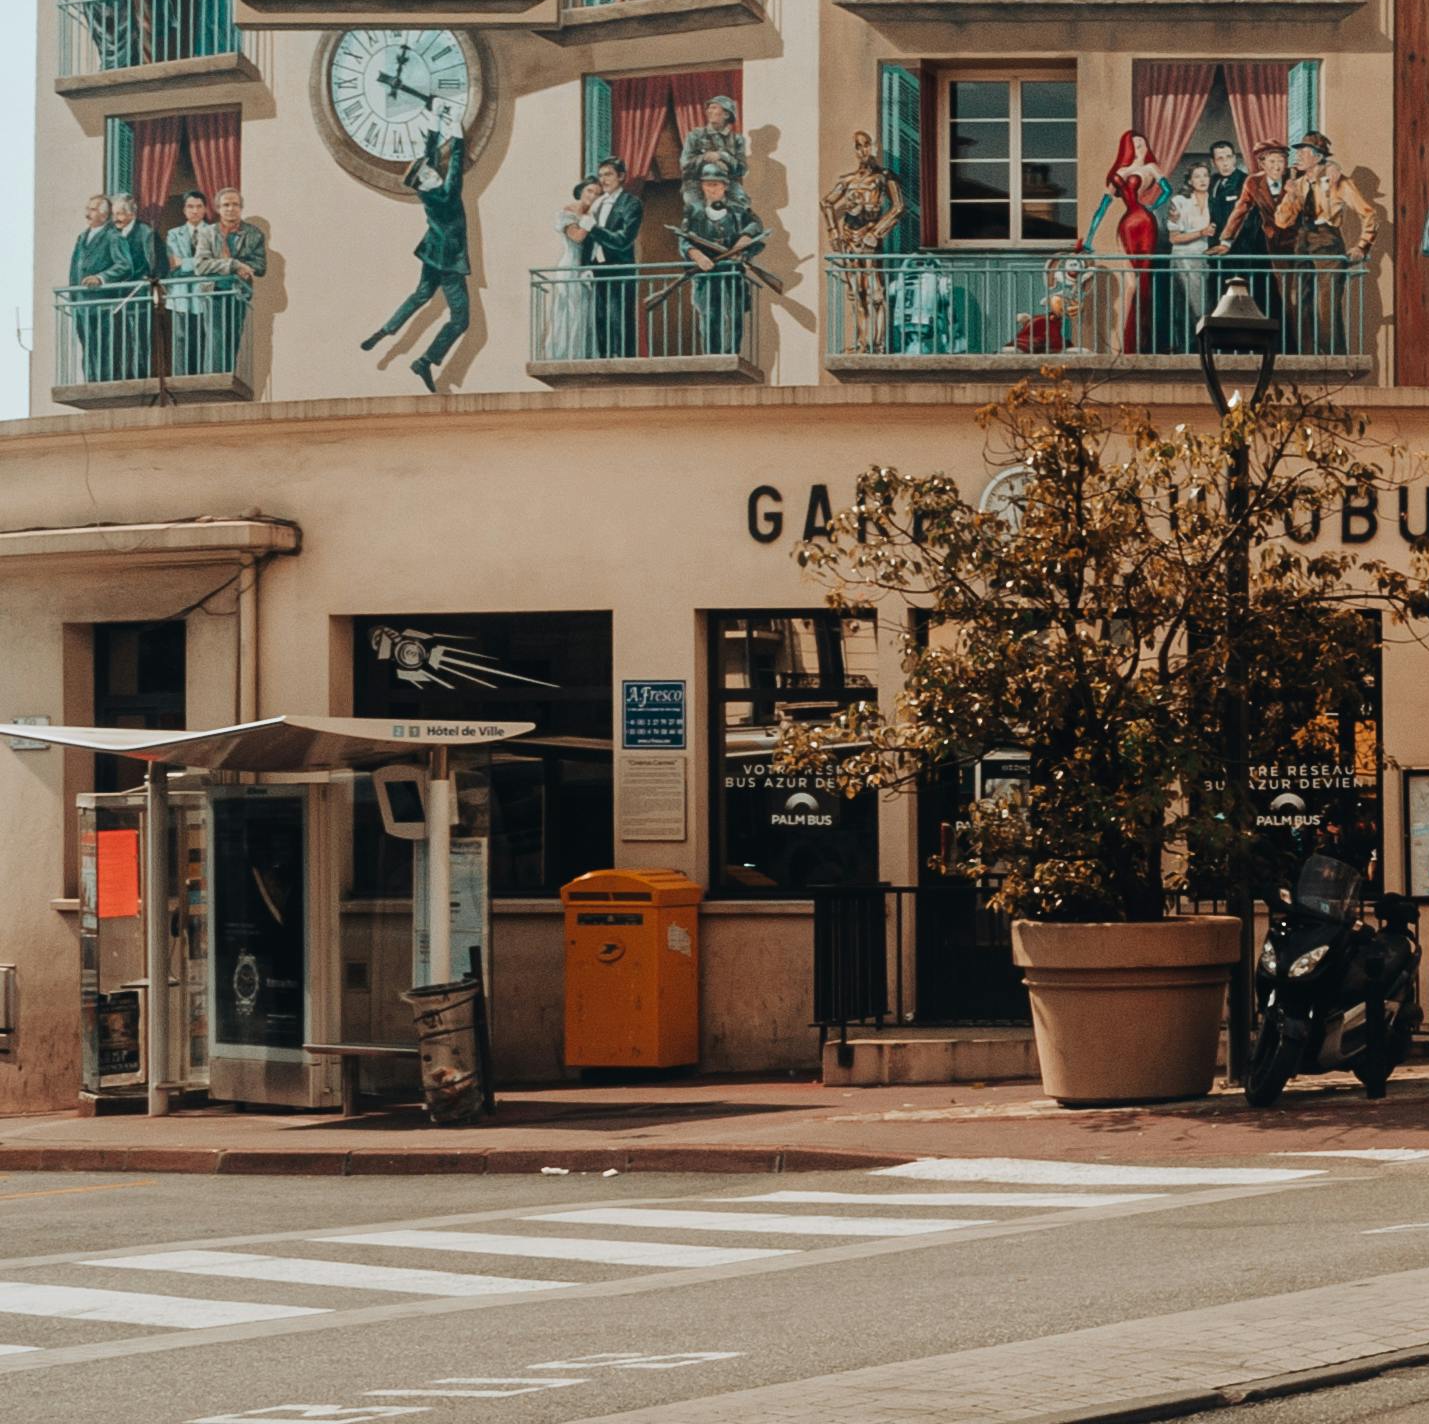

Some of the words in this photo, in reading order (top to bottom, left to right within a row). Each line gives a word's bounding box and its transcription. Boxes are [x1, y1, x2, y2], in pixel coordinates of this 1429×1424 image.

[627, 686, 683, 707] A.Fresco
[426, 726, 459, 736] Hôtel
[462, 726, 476, 736] de
[478, 726, 504, 737] Ville
[725, 777, 756, 788] BUS
[764, 777, 807, 788] AZUR
[771, 814, 805, 825] PALM
[807, 814, 832, 826] BUS
[1256, 815, 1291, 826] PALM
[1294, 814, 1321, 826] BUS
